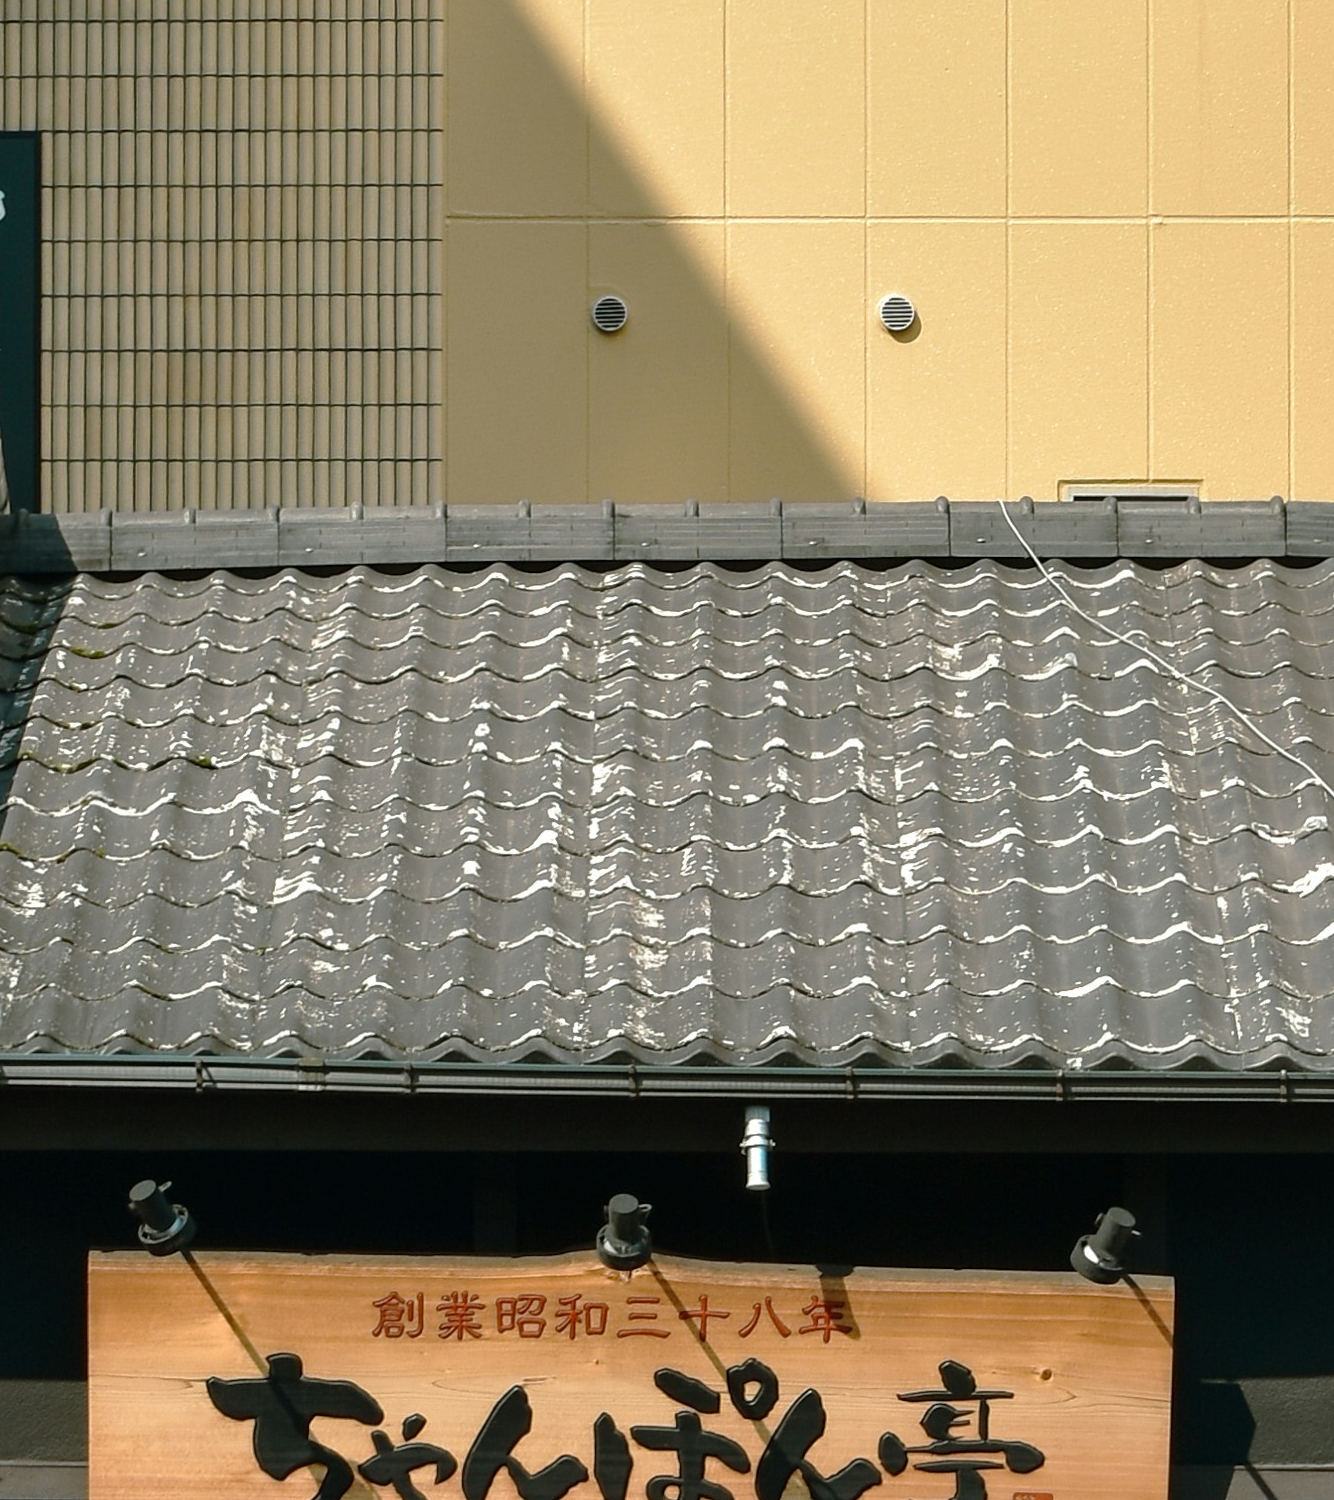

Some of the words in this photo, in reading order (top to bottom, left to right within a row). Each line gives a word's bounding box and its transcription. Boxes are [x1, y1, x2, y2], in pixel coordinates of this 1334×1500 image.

[373, 1291, 855, 1344] 創業昭和三十八年
